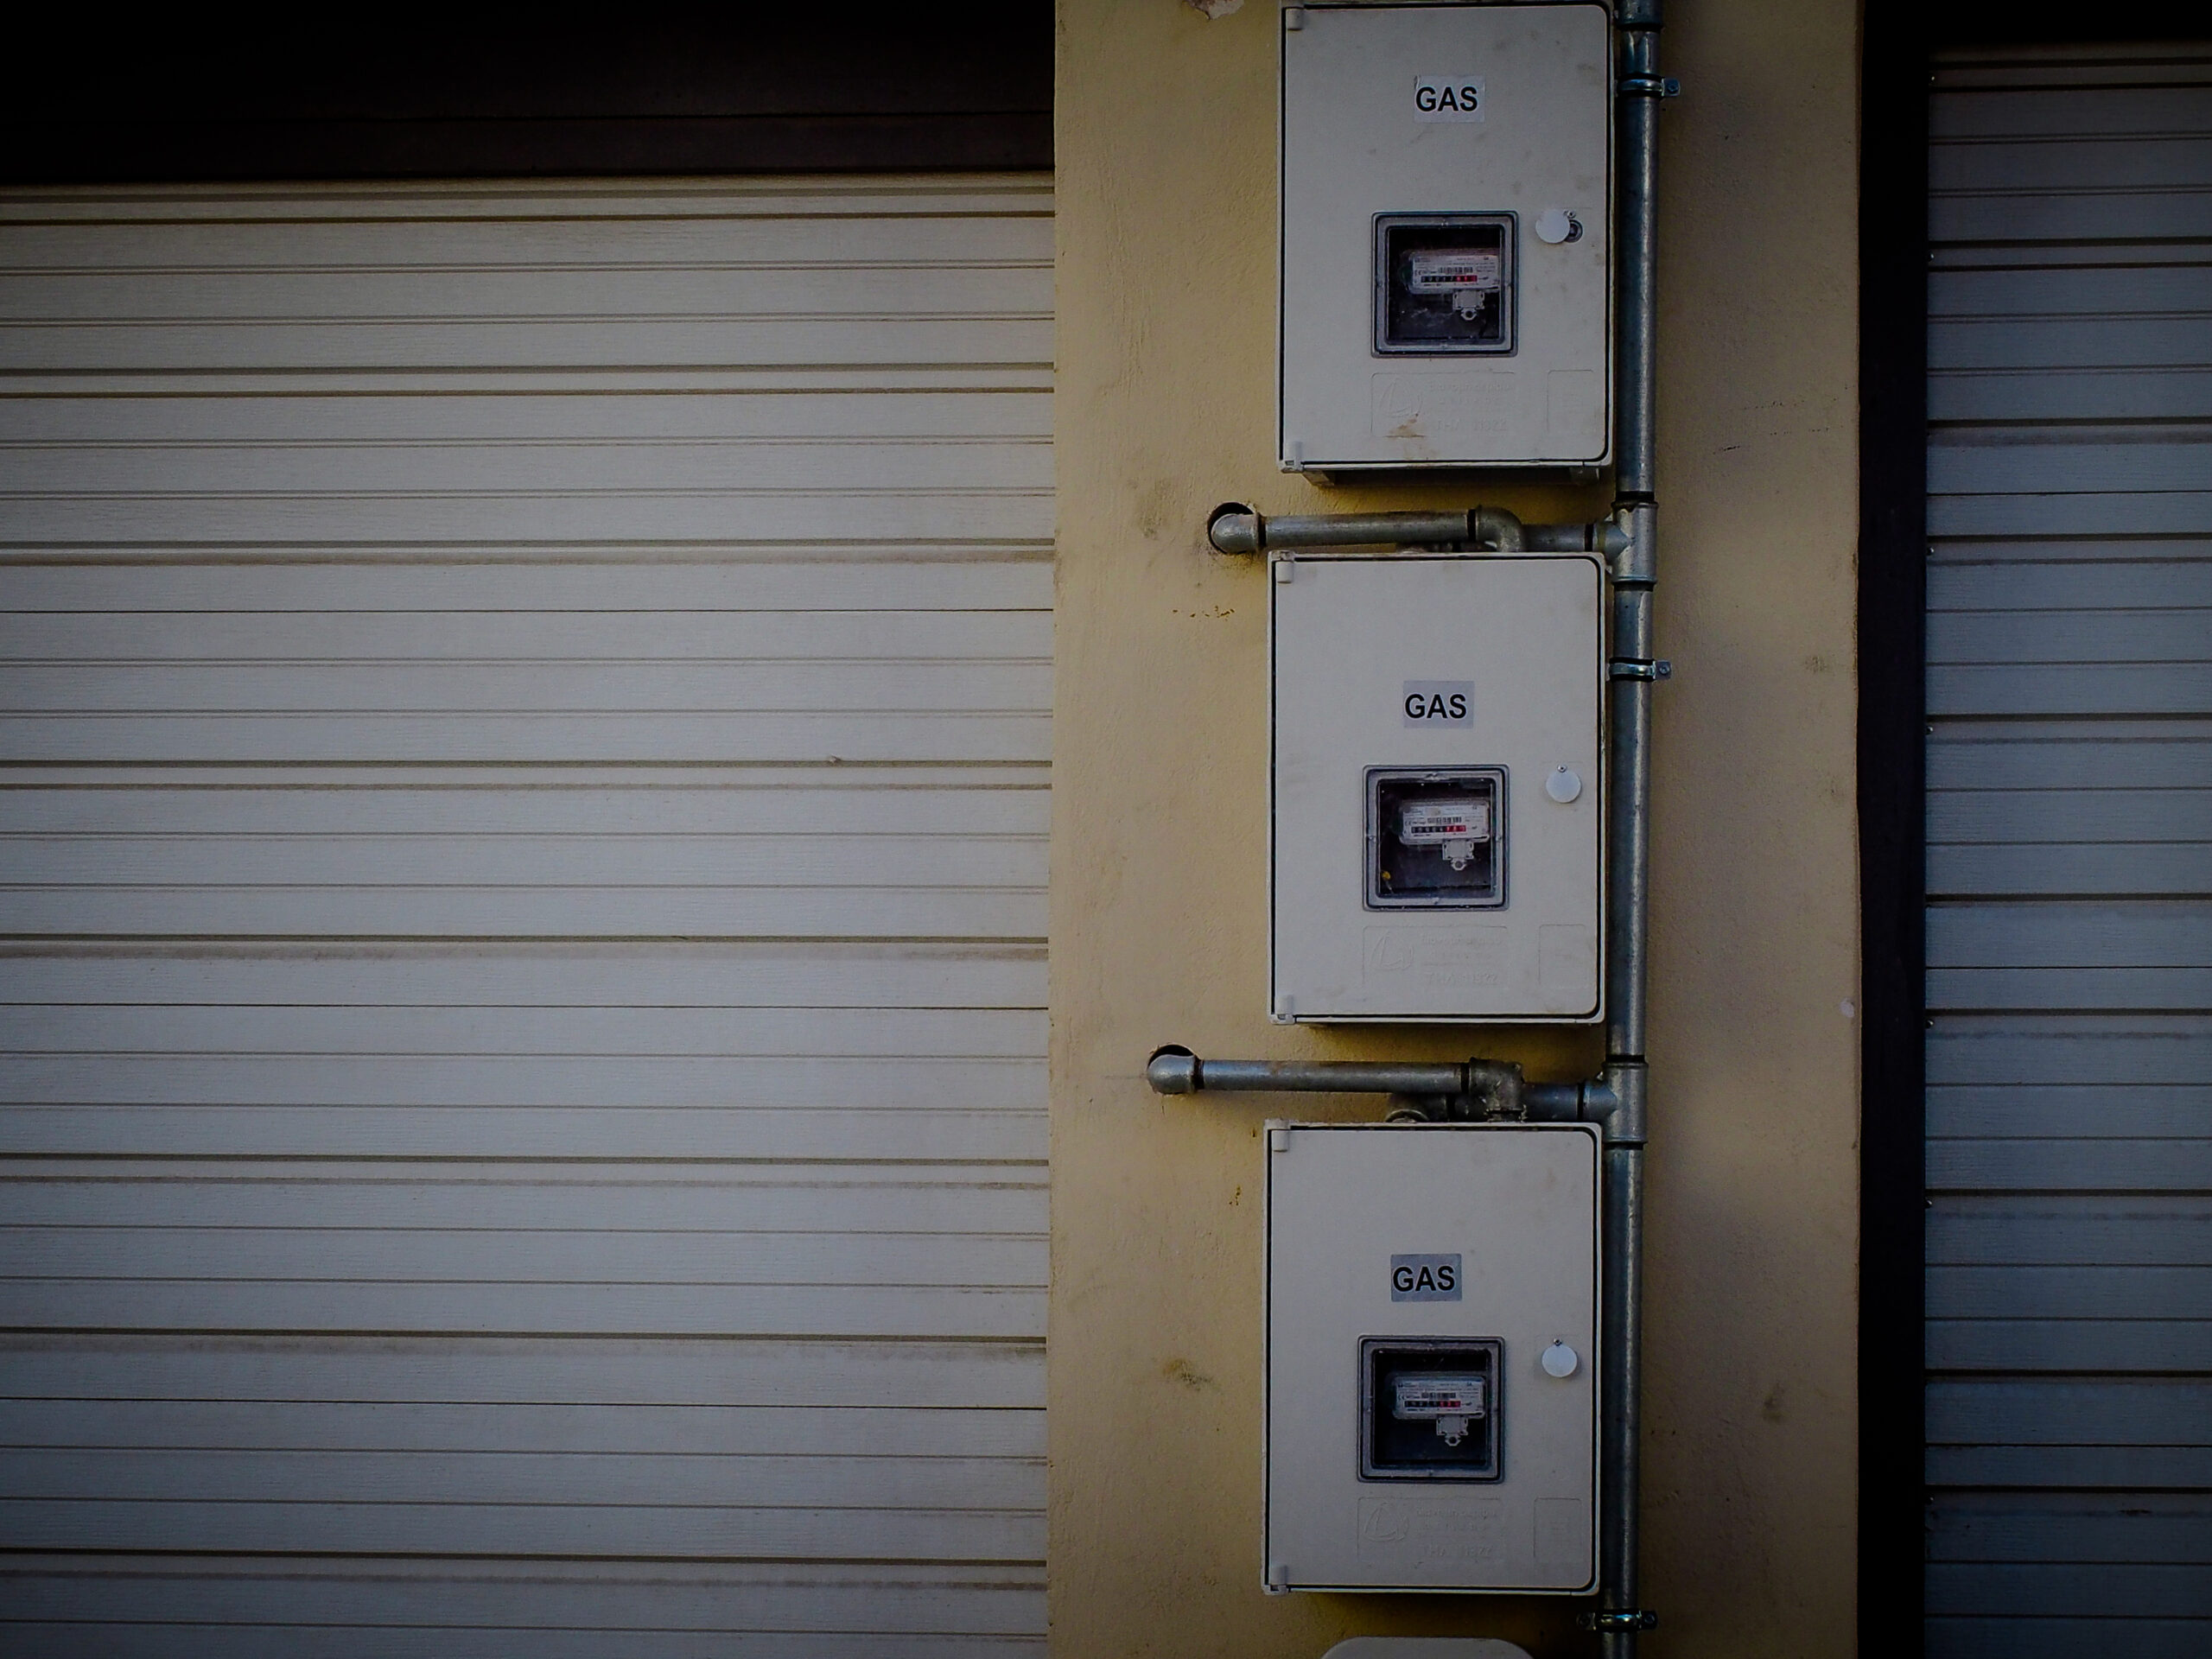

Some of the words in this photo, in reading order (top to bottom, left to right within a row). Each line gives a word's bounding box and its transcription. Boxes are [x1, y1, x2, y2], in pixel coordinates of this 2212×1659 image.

[1415, 86, 1478, 112] GAS
[1405, 693, 1467, 719] GAS
[1393, 1265, 1455, 1293] GAS
